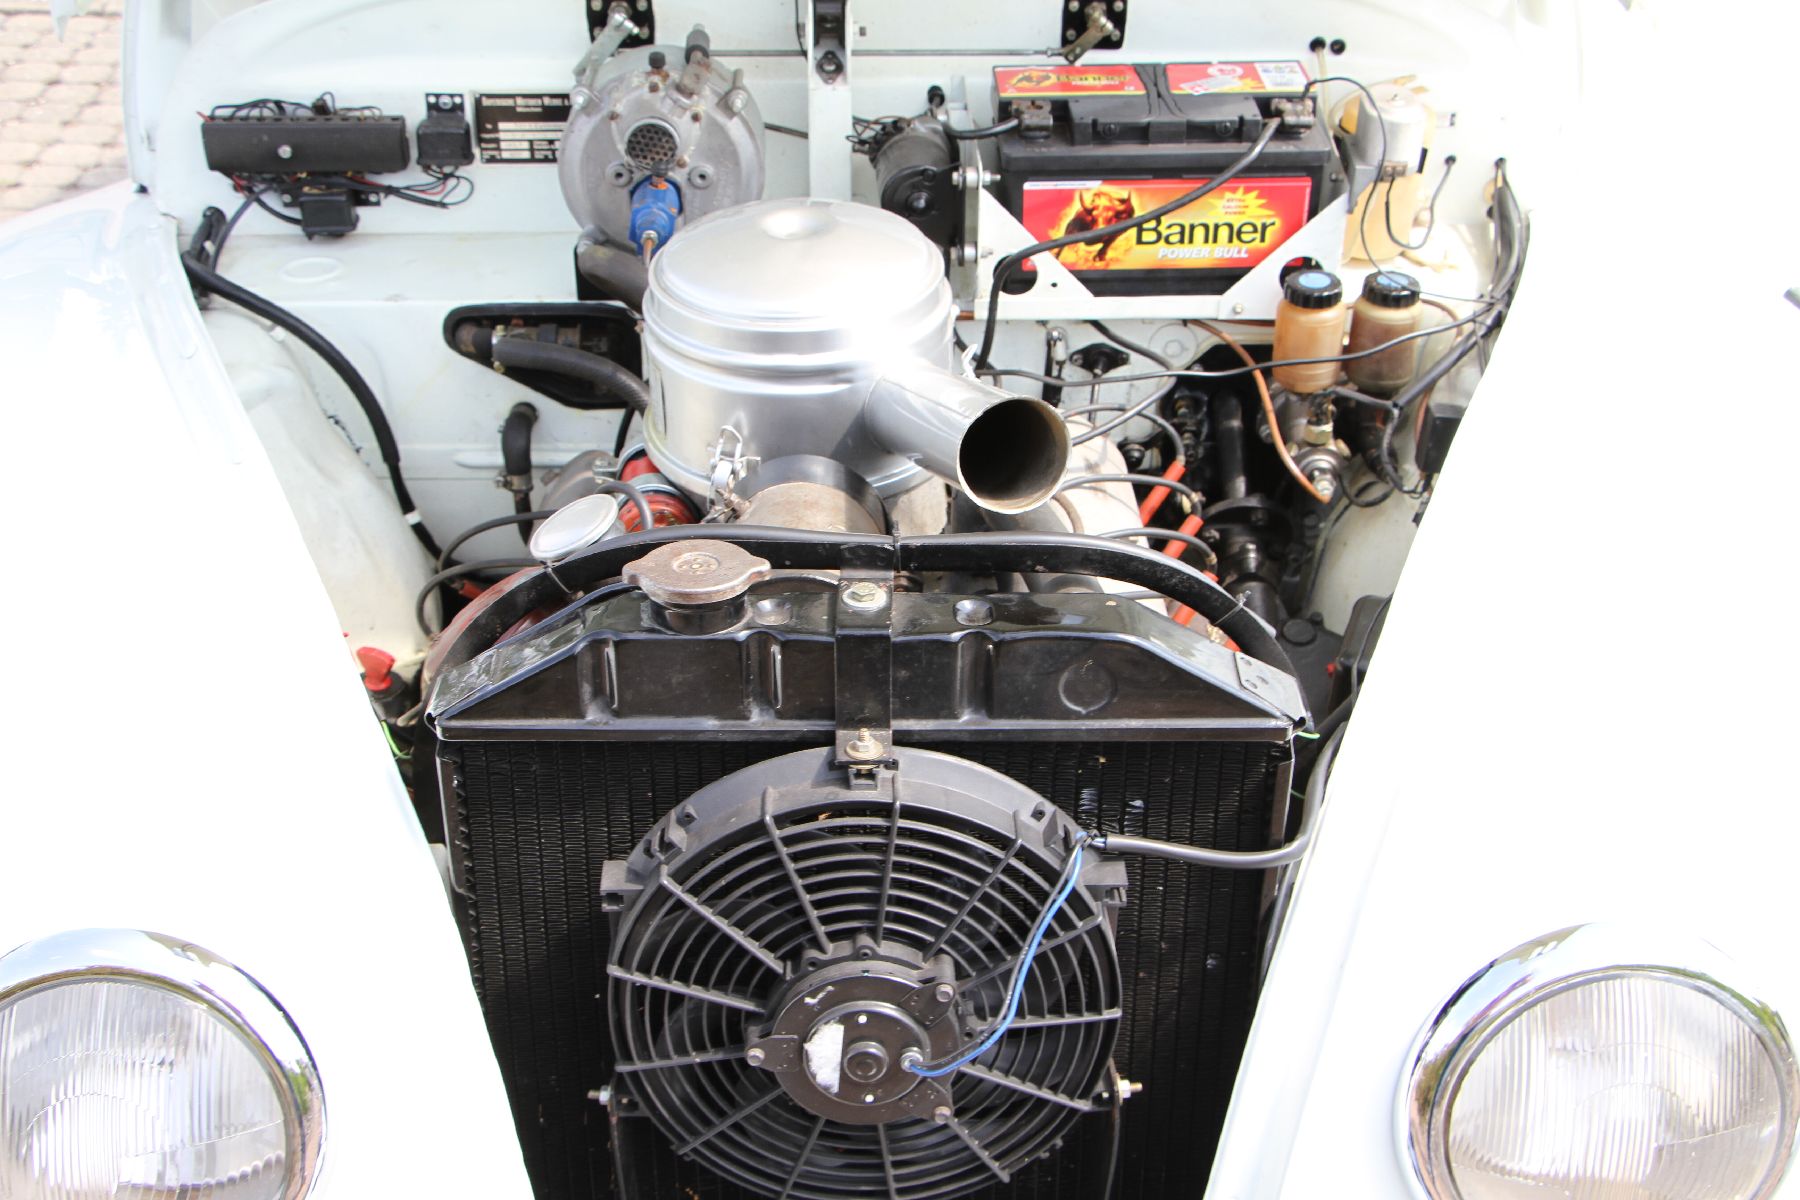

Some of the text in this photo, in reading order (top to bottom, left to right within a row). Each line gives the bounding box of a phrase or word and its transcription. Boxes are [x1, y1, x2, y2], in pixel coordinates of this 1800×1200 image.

[1135, 216, 1277, 246] Banner
[1158, 246, 1249, 259] POWER BULL
